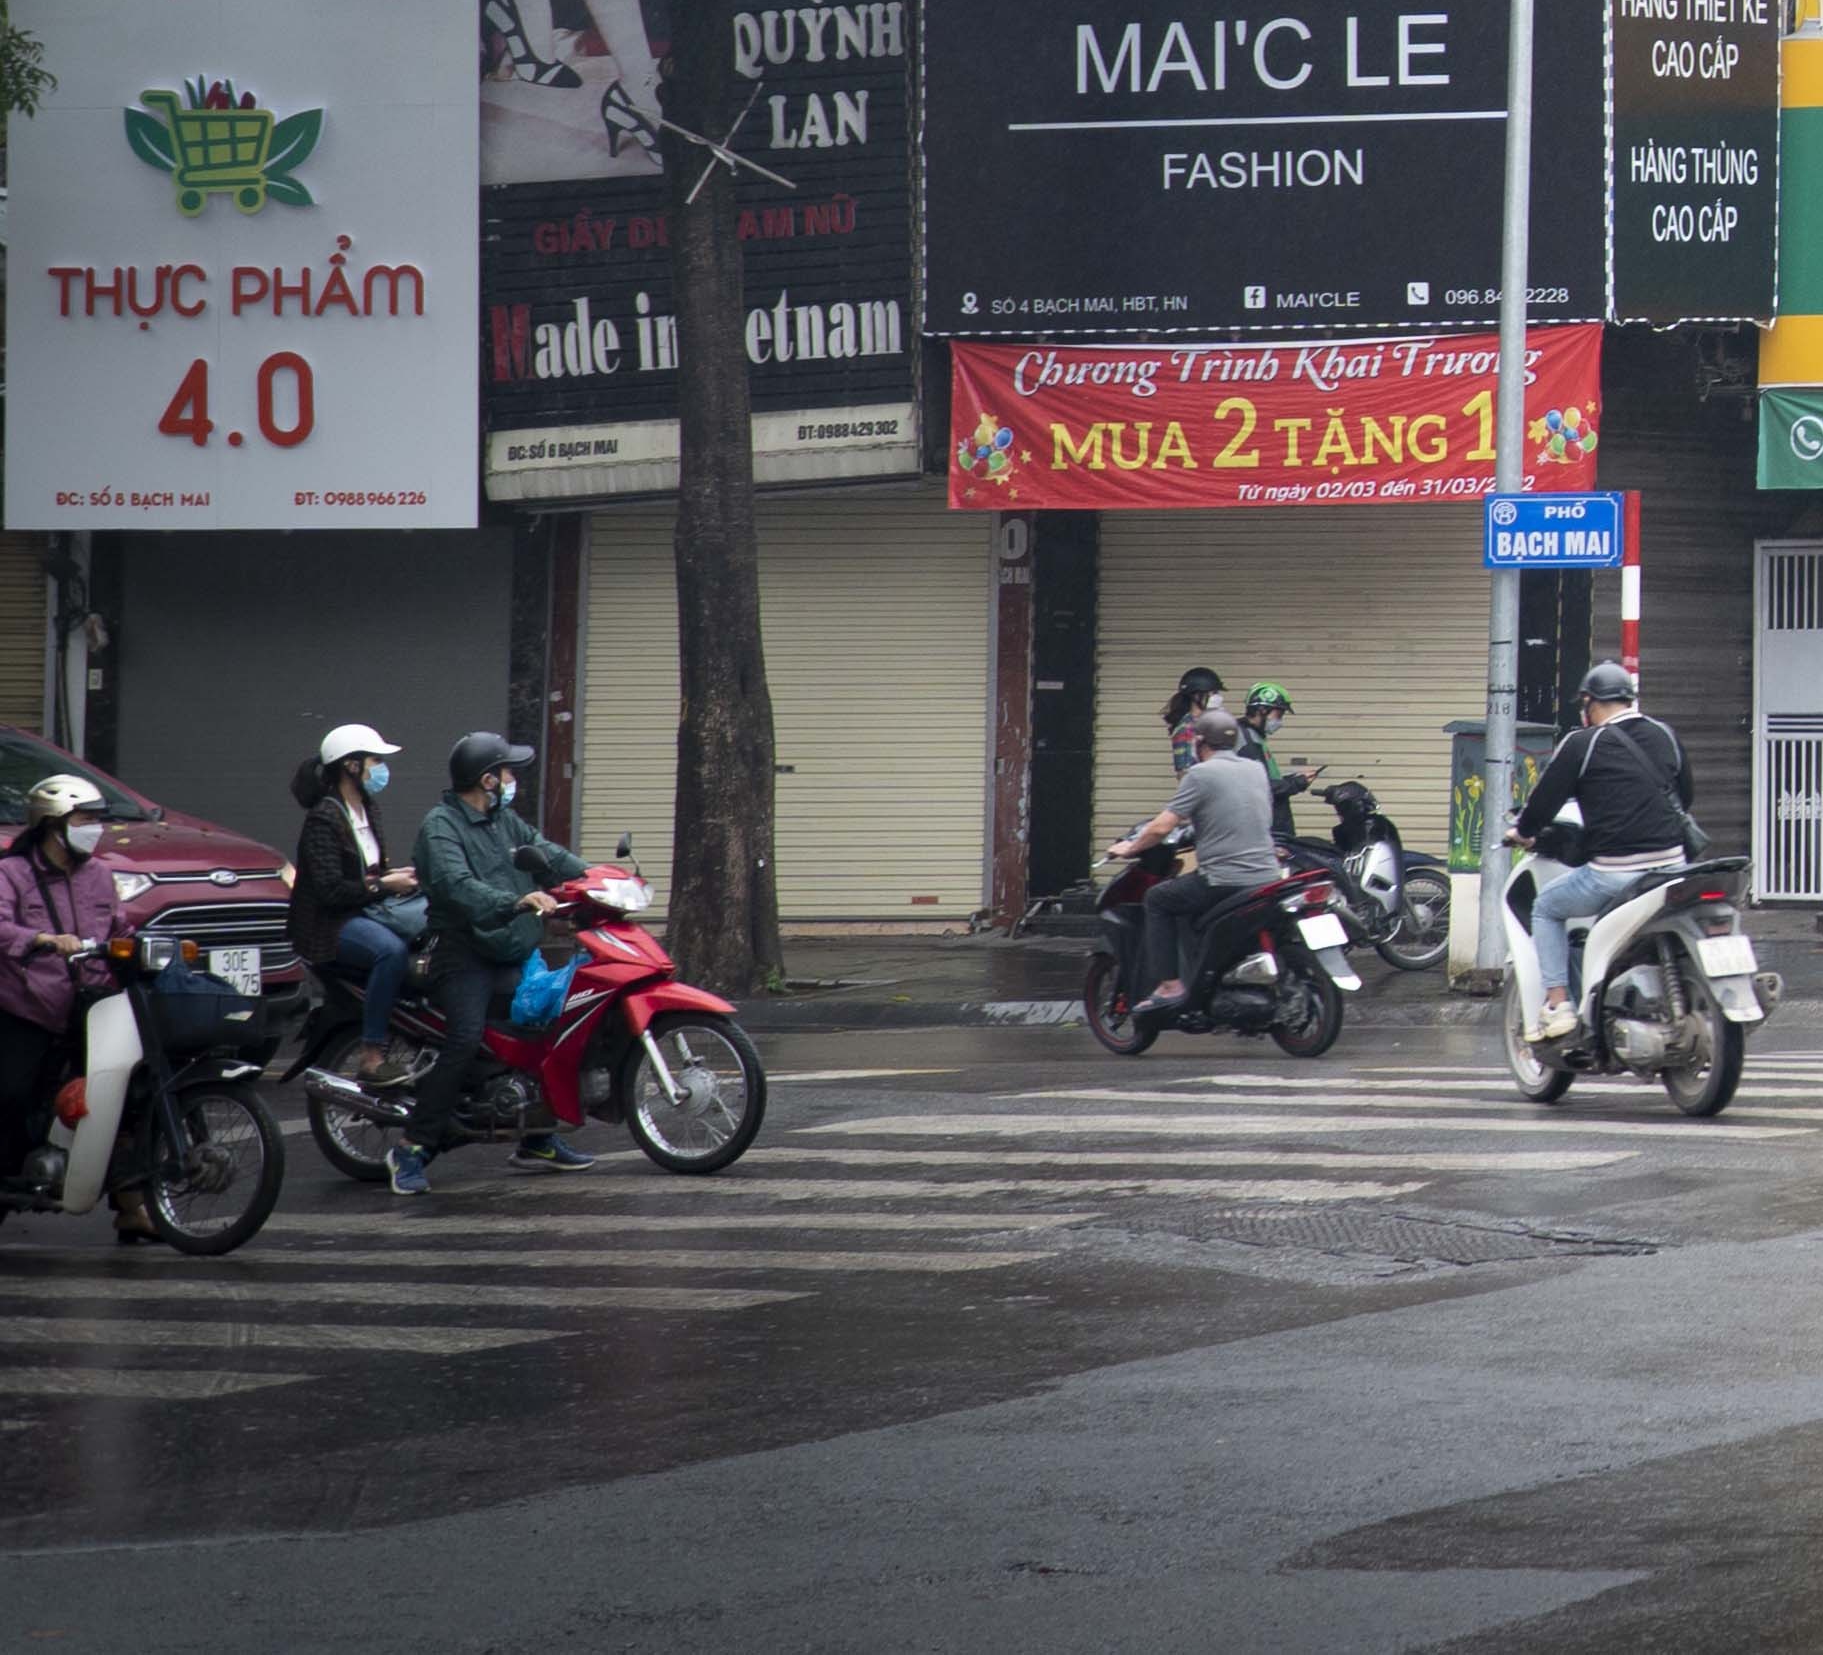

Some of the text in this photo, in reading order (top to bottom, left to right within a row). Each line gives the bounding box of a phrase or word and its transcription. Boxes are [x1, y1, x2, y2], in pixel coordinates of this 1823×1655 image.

[1075, 12, 1450, 95] MAI'C LE
[1651, 34, 1740, 81] CAO CẤP
[770, 90, 869, 150] LAN
[1162, 148, 1365, 191] FASHION
[1630, 142, 1759, 187] HÀNG THÙNG
[534, 207, 616, 254] GIẦY
[1651, 199, 1739, 244] CAO CẤP
[47, 234, 426, 332] THỰC PHẨM
[991, 290, 1361, 316] SỐ 4 BẠCH MAI, HBT, HN MAI'CLE
[489, 295, 621, 382] Made
[1013, 344, 1382, 397] Chương Trình Khai
[158, 351, 315, 449] 4.0
[558, 445, 590, 461] BẠCH
[594, 440, 618, 456] MAI
[1049, 391, 1498, 475] MUA 2 TẶNG 1
[56, 492, 85, 506] ĐC:
[90, 485, 112, 507] SỐ
[115, 492, 126, 506] 8
[130, 492, 174, 510] BẠCH
[180, 492, 210, 506] MAI
[294, 492, 320, 506] ĐT:
[1237, 477, 1419, 506] Từ ngày 02/03 đến
[1543, 498, 1586, 519] PHỐ
[1496, 529, 1611, 563] BẠCH MAI
[222, 950, 249, 972] 30E
